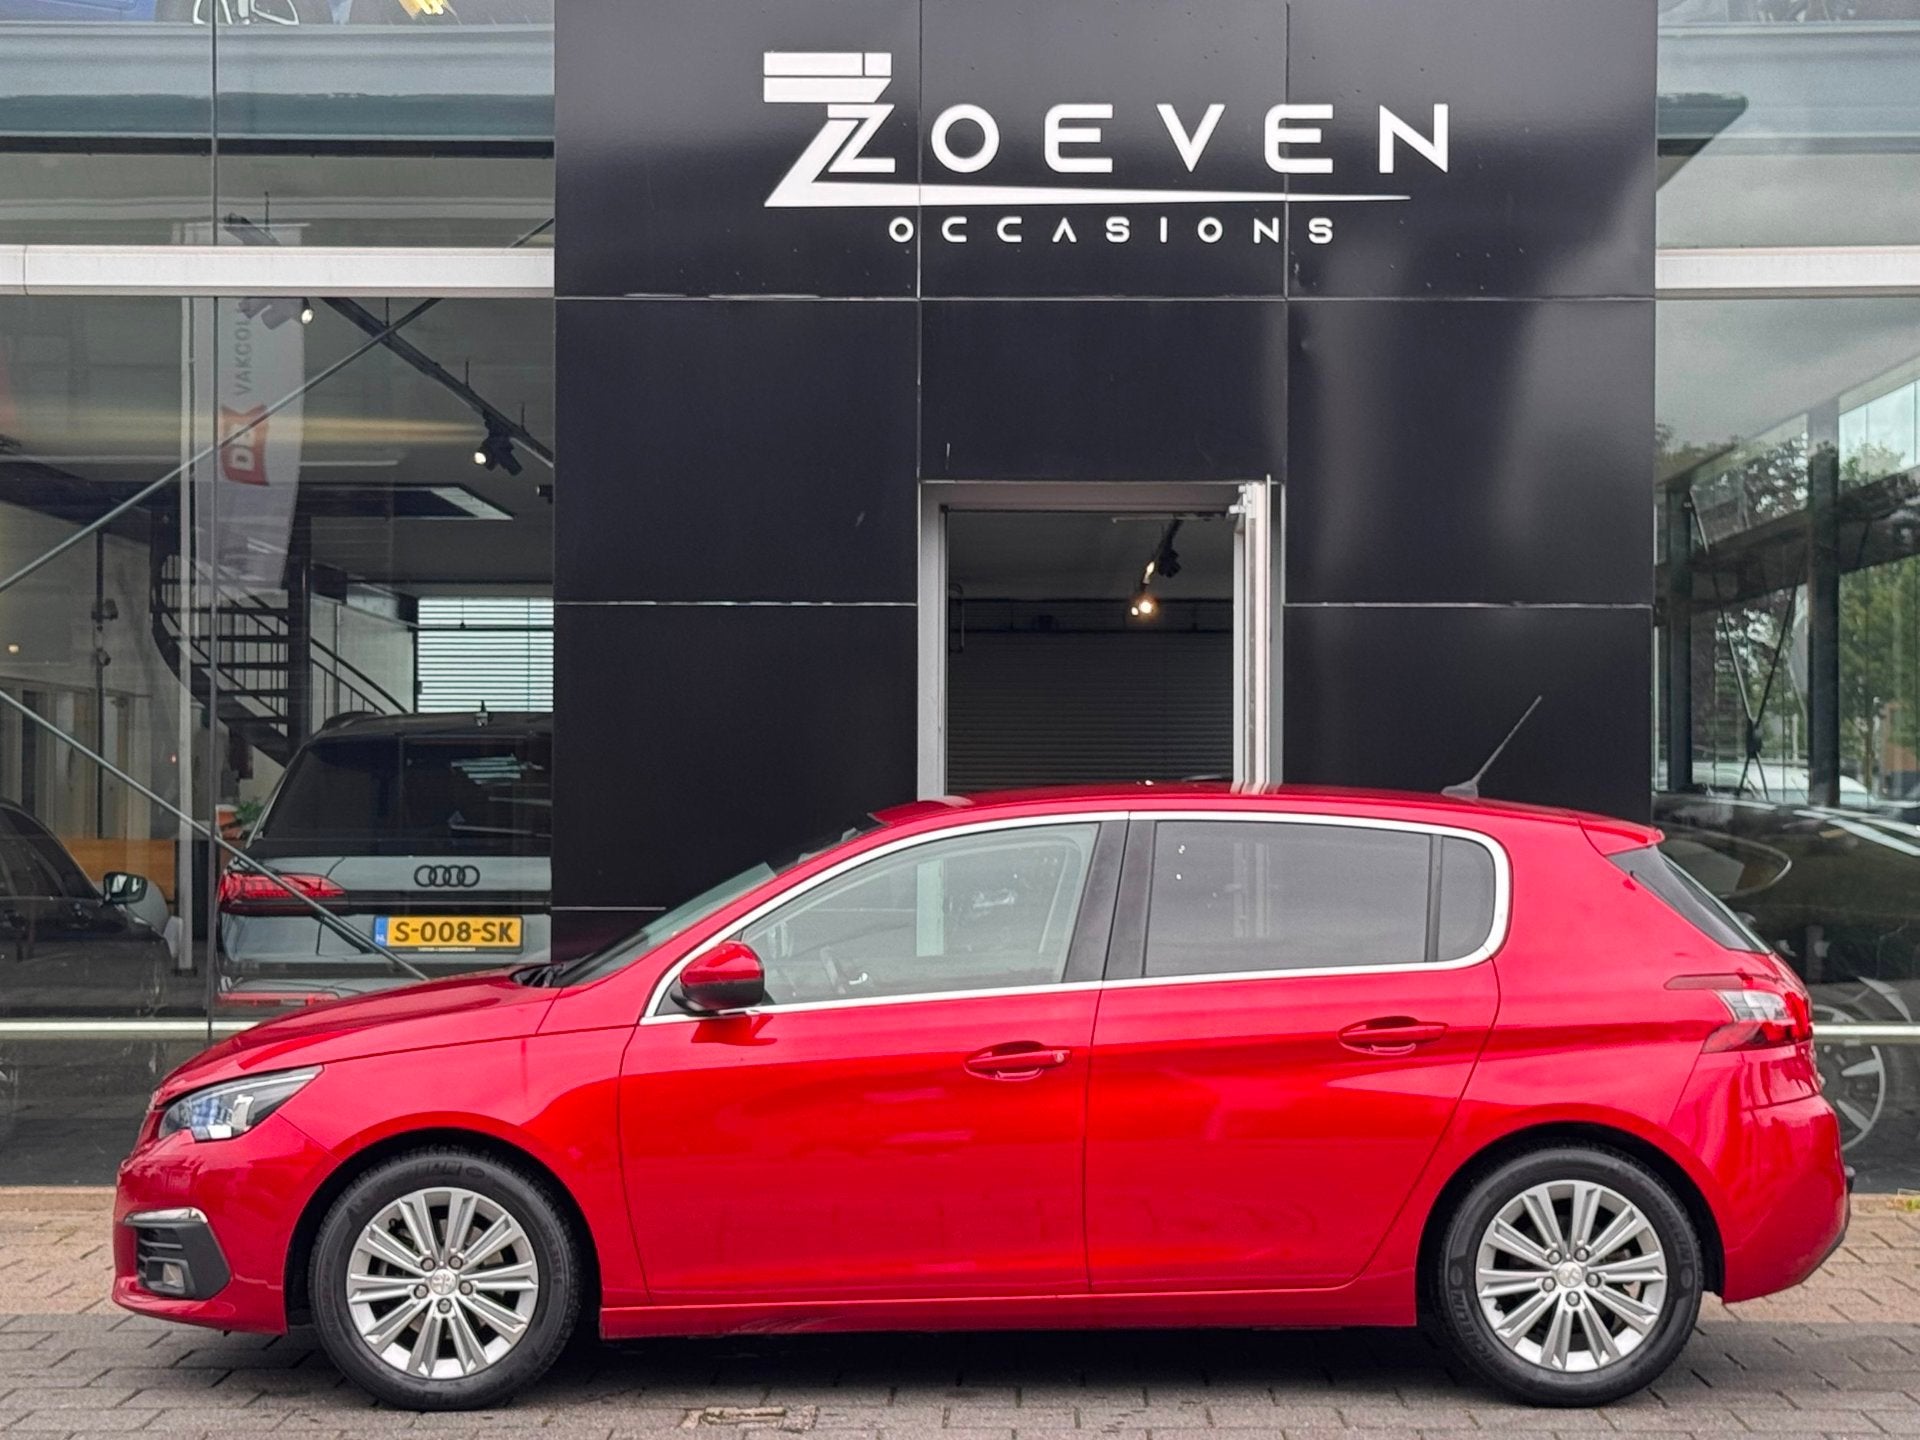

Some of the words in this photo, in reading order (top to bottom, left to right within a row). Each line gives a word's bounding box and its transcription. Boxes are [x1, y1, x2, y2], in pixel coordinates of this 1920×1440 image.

[763, 52, 1449, 207] ZOEVEN
[888, 216, 1334, 244] OCCASIONS
[394, 921, 514, 943] S-008-SK
